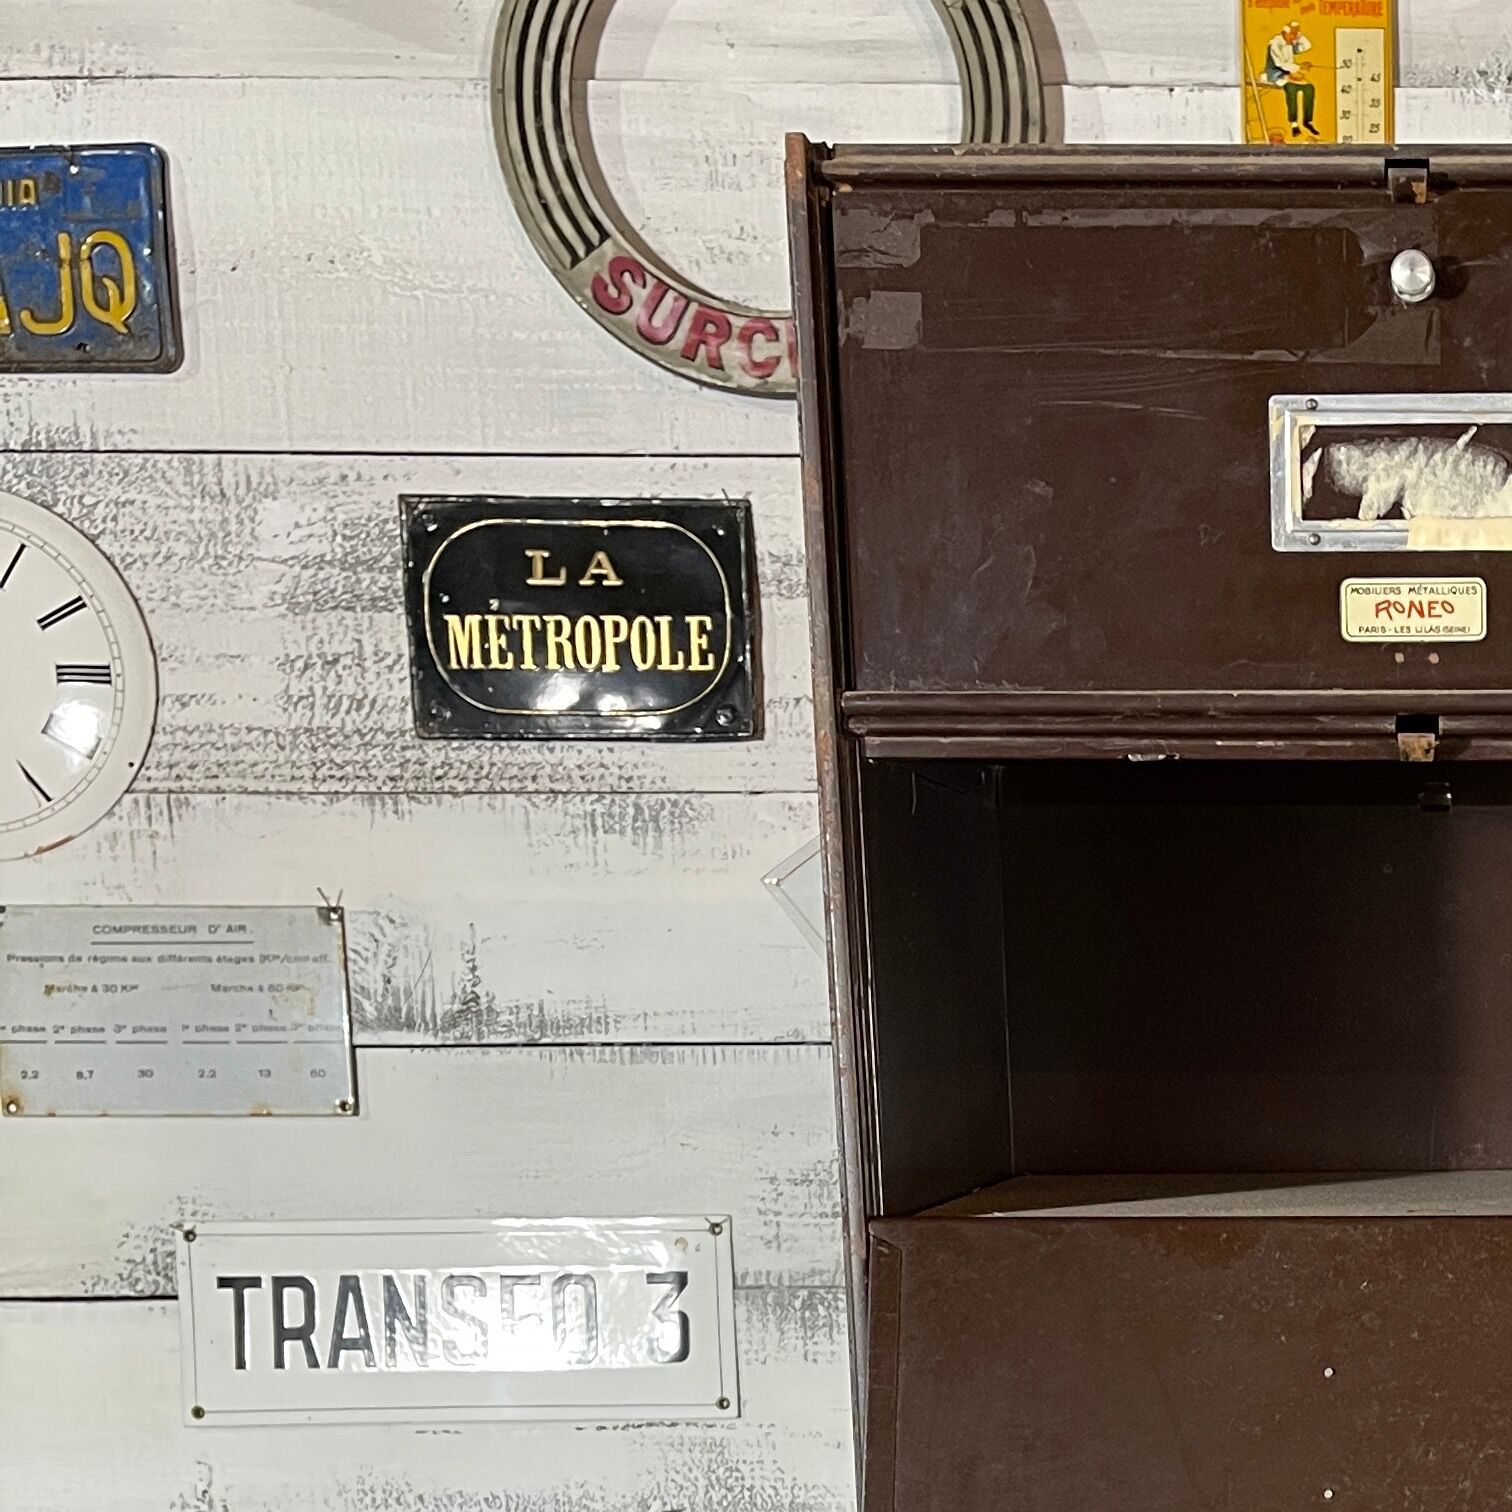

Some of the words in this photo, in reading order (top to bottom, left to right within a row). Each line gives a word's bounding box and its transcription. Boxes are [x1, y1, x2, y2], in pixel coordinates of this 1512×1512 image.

[0, 178, 37, 206] IA
[525, 549, 624, 587] LA
[92, 924, 197, 935] COMPRESSEUR
[68, 954, 82, 963] de
[102, 984, 118, 994] 30
[211, 983, 253, 994] Marche
[137, 1069, 154, 1079] 30
[645, 1270, 690, 1364] 3
